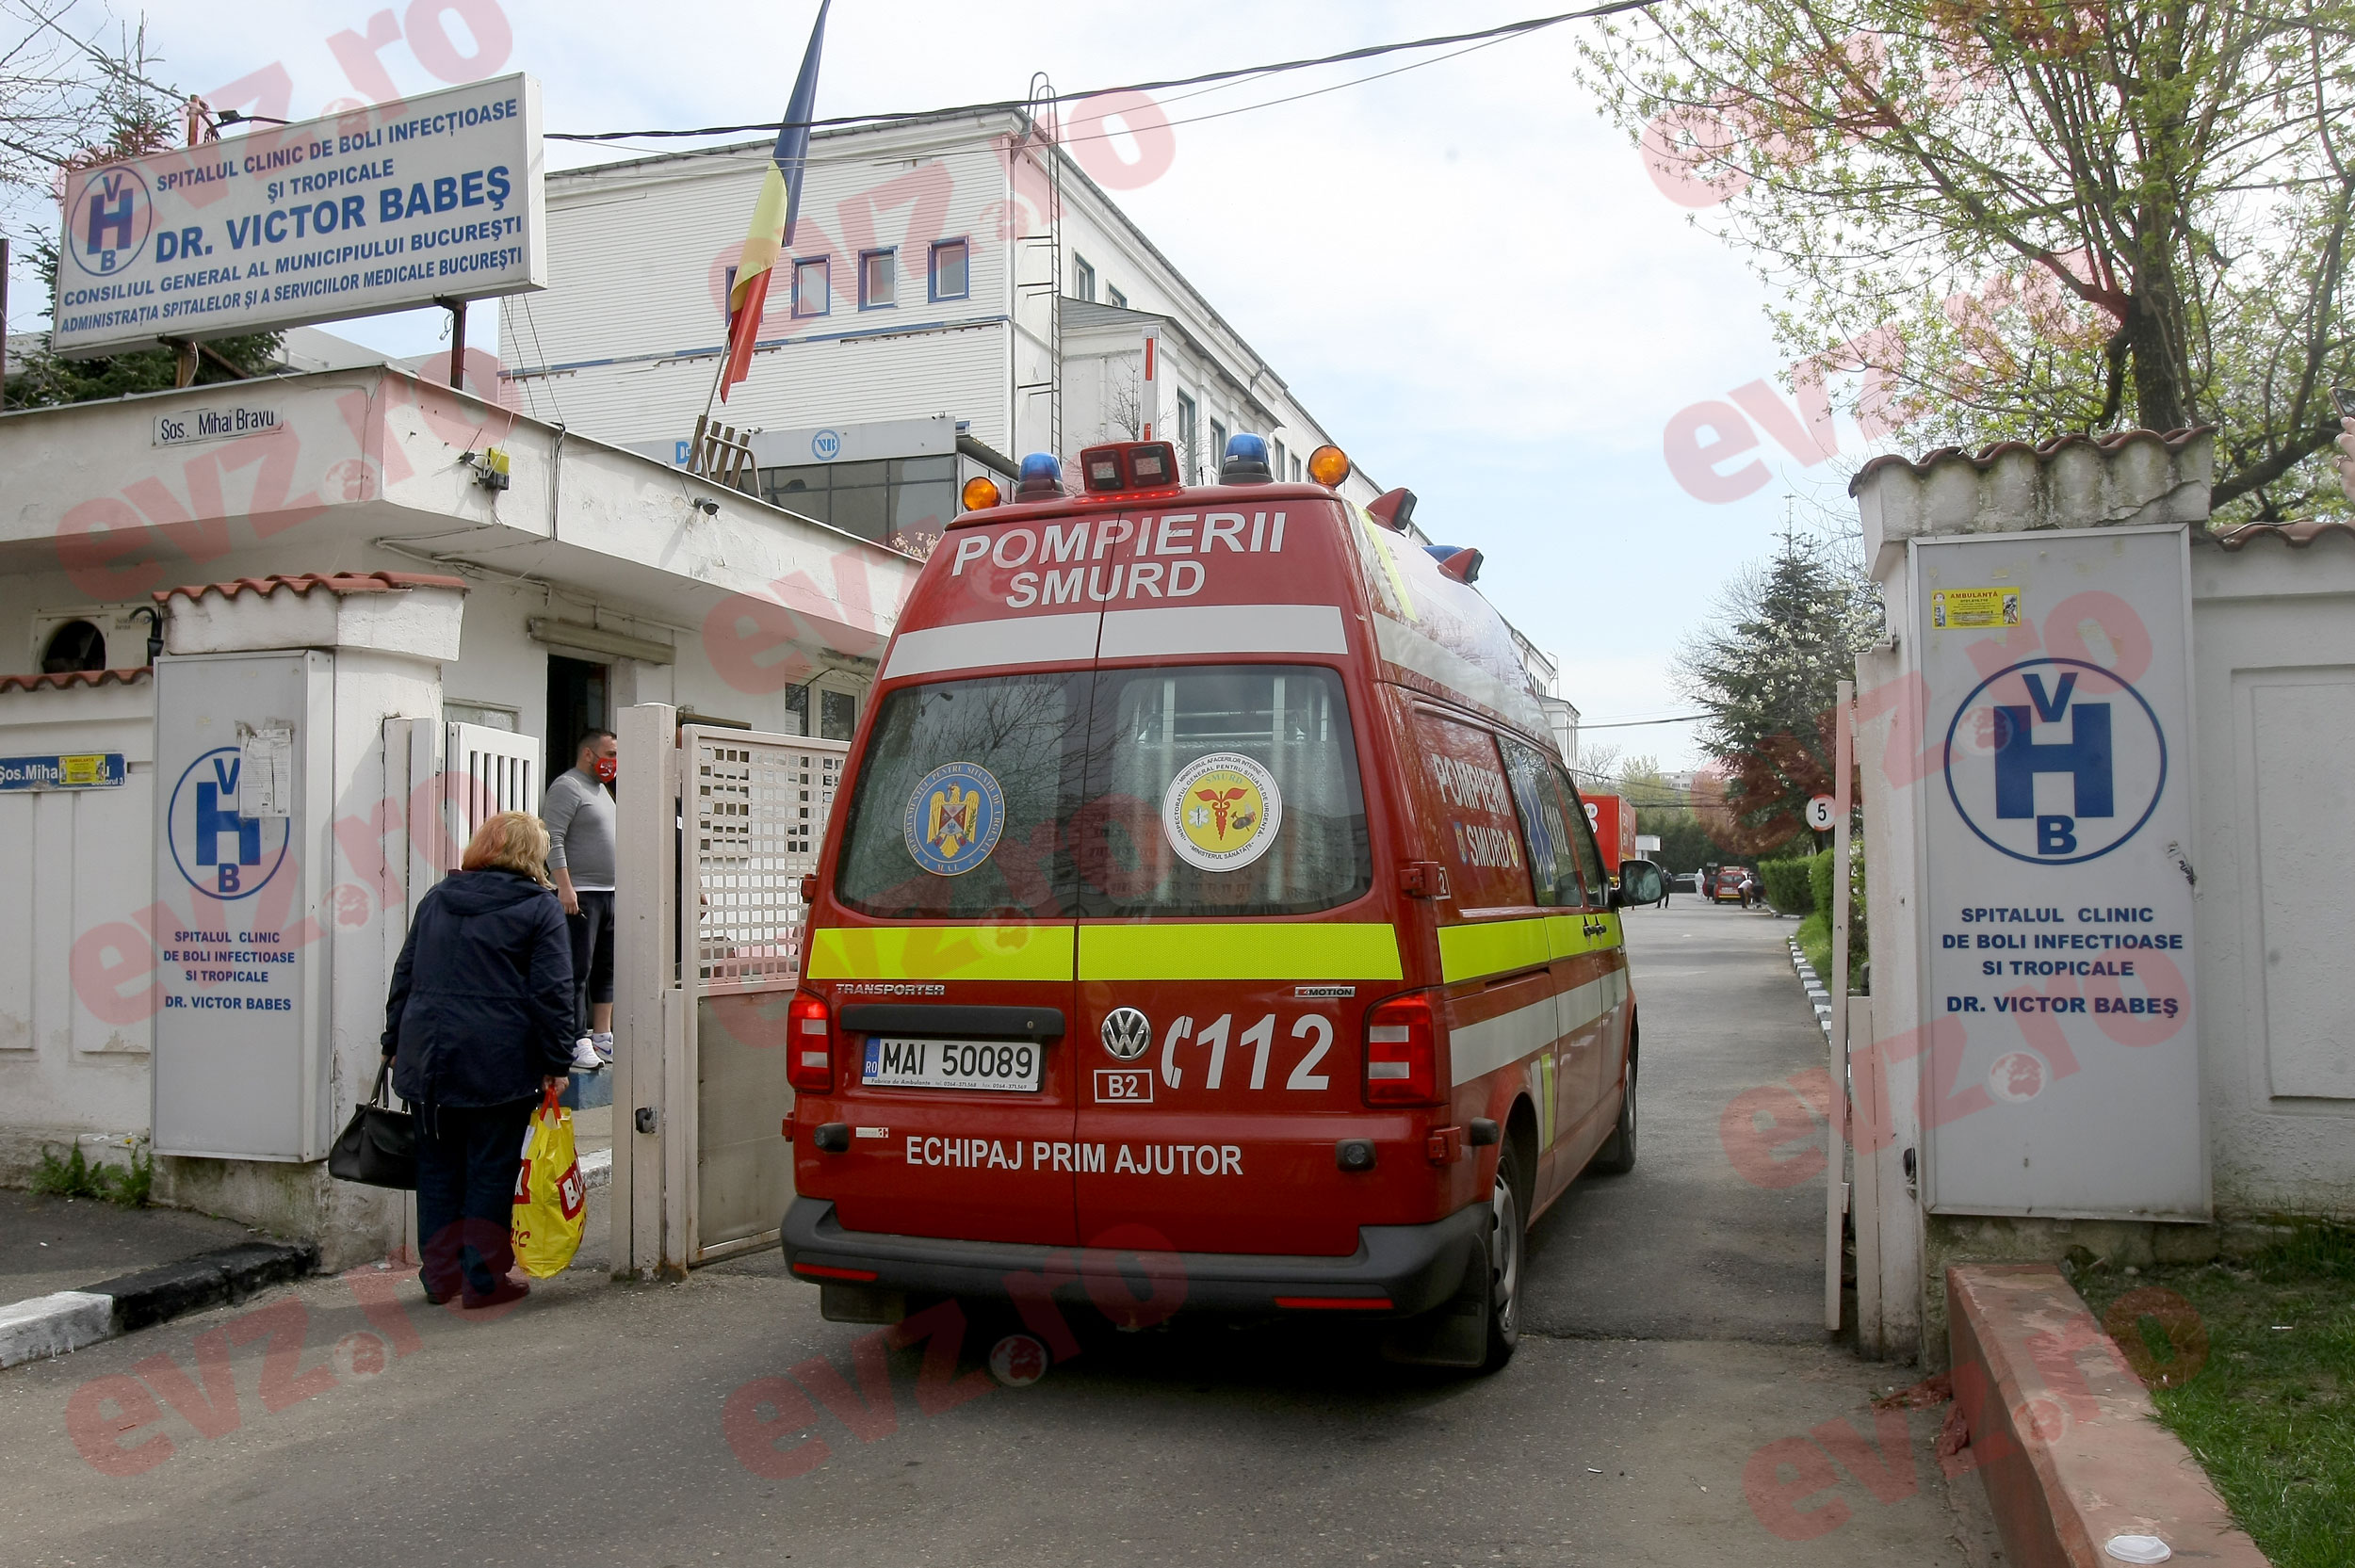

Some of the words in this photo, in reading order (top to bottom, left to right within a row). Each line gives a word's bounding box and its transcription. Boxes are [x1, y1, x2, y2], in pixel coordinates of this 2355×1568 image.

[157, 160, 238, 191] SPITALUL
[244, 145, 303, 173] CLINIC
[309, 139, 333, 160] DE
[339, 128, 382, 154] BOLI
[290, 159, 394, 195] TROPICALE
[155, 226, 213, 264] DR.
[225, 194, 366, 251] VICTOR
[64, 281, 154, 307] CONSILIUL
[160, 266, 241, 293] GENERAL
[247, 263, 269, 279] AL
[275, 236, 404, 274] MUNICIPIULUI
[162, 292, 240, 318] SPITALELOR
[261, 288, 270, 304] A
[274, 273, 359, 302] SERVICIILOR
[363, 261, 434, 288] MEDICALE
[199, 409, 232, 436] Mihai
[236, 408, 274, 430] Bravu
[950, 511, 1287, 576] POMPIERII
[1006, 560, 1206, 608] SMURD
[1178, 761, 1207, 783] MINISTERUL
[1207, 756, 1241, 765] AFACERILOR
[1241, 759, 1262, 776] INTERNE
[1205, 772, 1243, 784] SMURD
[1432, 752, 1511, 816] POMPIERII
[1174, 785, 1188, 840] INSPECTORATUL
[1186, 767, 1215, 785] GENERAL
[1215, 764, 1243, 773] PENTRU
[1261, 791, 1268, 801] DE
[1817, 802, 1827, 821] 5
[1191, 844, 1224, 860] MINISTERUL
[1466, 824, 1510, 868] SMURD
[1960, 907, 2064, 923] SPITALUL
[2077, 907, 2154, 923] CLINIC
[174, 930, 232, 943] SPITALUL
[239, 931, 281, 944] CLINIC
[1941, 933, 1970, 950] DE
[1976, 933, 2026, 950] BOLI
[2034, 933, 2183, 950] INFECTIOASE
[163, 950, 180, 962] DE
[183, 950, 211, 962] BOLI
[215, 951, 295, 963] INFECTIOASE
[1982, 960, 2003, 977] SI
[2008, 960, 2135, 977] TROPICALE
[185, 970, 197, 981] SI
[201, 970, 269, 983] TROPICALE
[836, 982, 946, 996] TRANSPORTER
[165, 996, 187, 1009] DR.
[191, 996, 242, 1010] VICTOR
[1946, 995, 1985, 1013] DR.
[1993, 995, 2086, 1014] VICTOR
[882, 1043, 926, 1075] MAI
[942, 1044, 1032, 1078] 50089
[1195, 1012, 1335, 1091] 112
[865, 1060, 877, 1074] RO
[1108, 1075, 1139, 1097] B2
[905, 1136, 1023, 1170] ECHIPAJ
[1032, 1140, 1106, 1173] PRIM
[1113, 1143, 1243, 1175] AJUTOR
